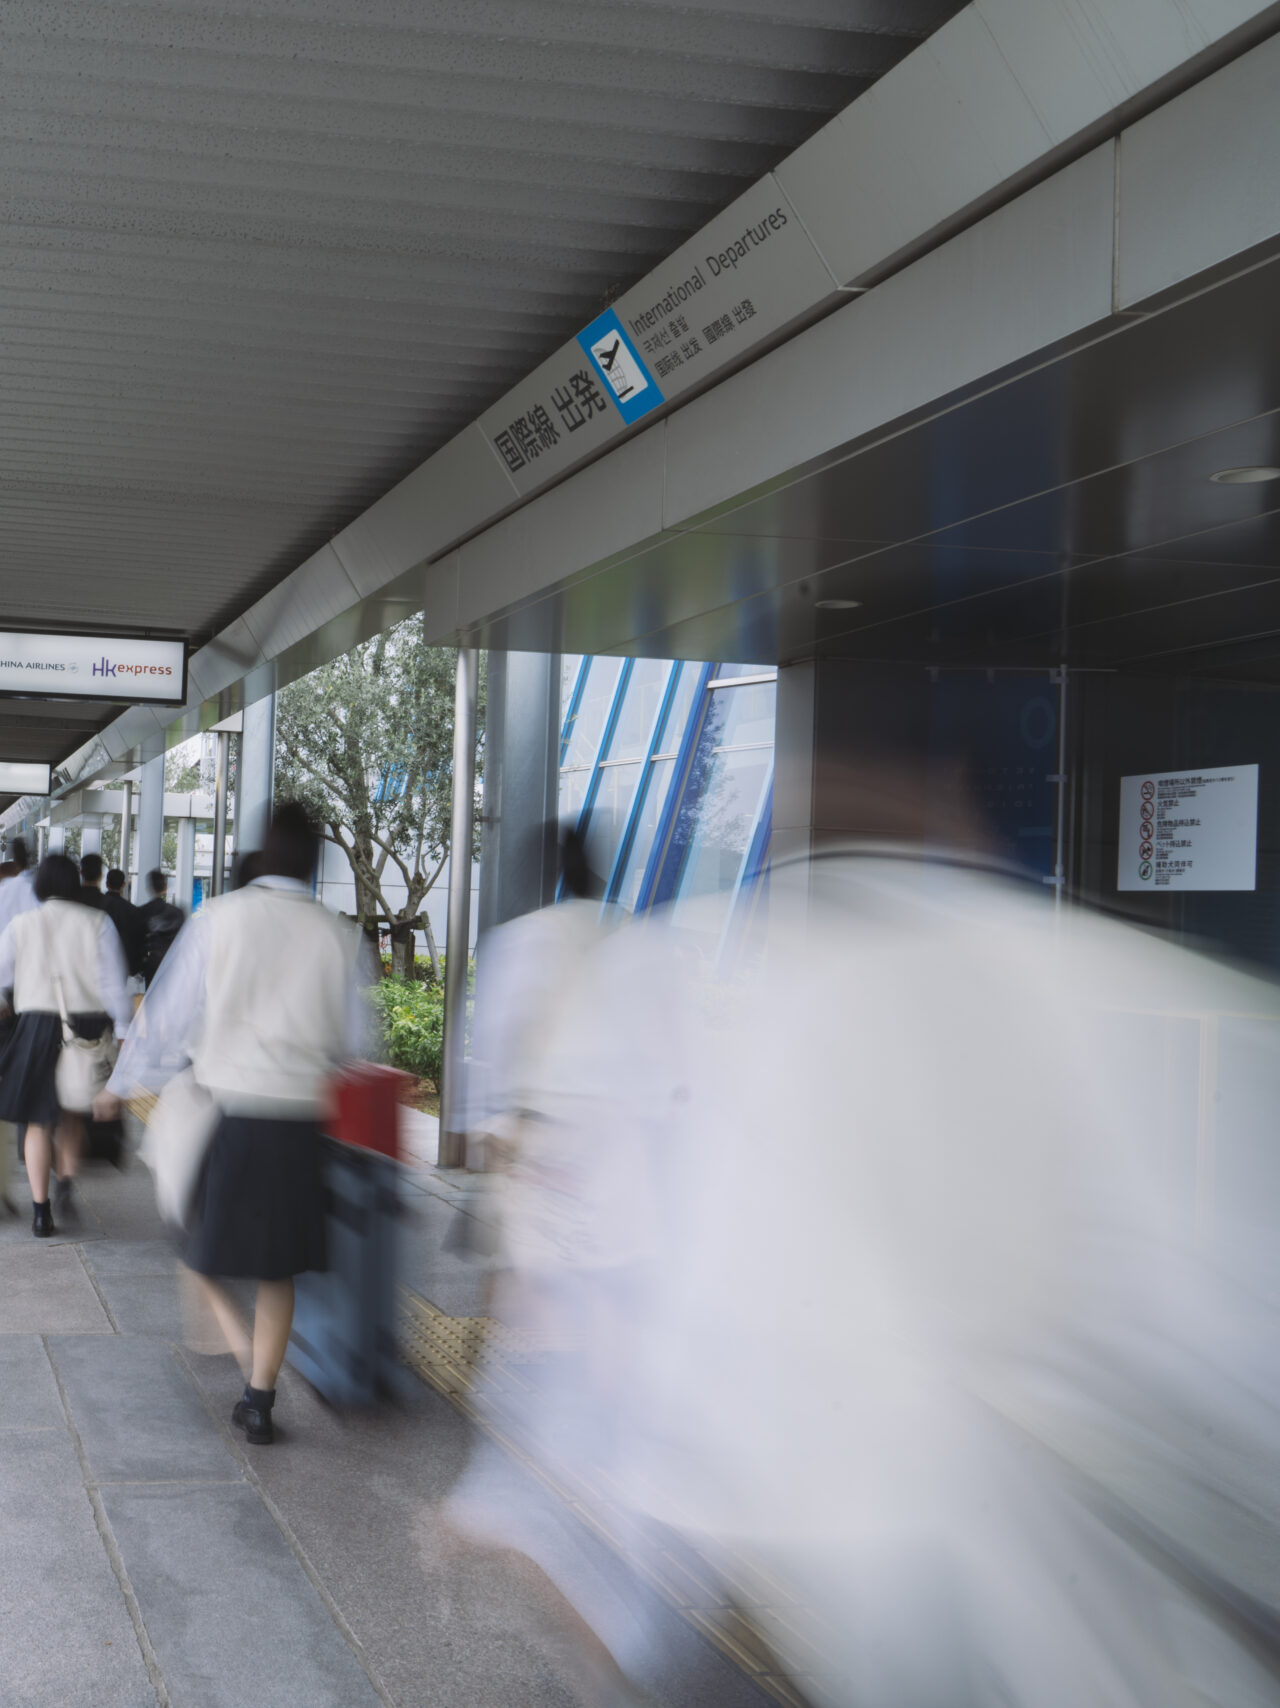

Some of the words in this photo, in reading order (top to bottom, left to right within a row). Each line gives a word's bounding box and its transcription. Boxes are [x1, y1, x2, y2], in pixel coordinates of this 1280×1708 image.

[629, 266, 706, 336] International
[706, 208, 787, 277] Departures
[493, 404, 560, 473] 国際線
[551, 370, 607, 433] 出発
[25, 662, 65, 671] AIRLINES
